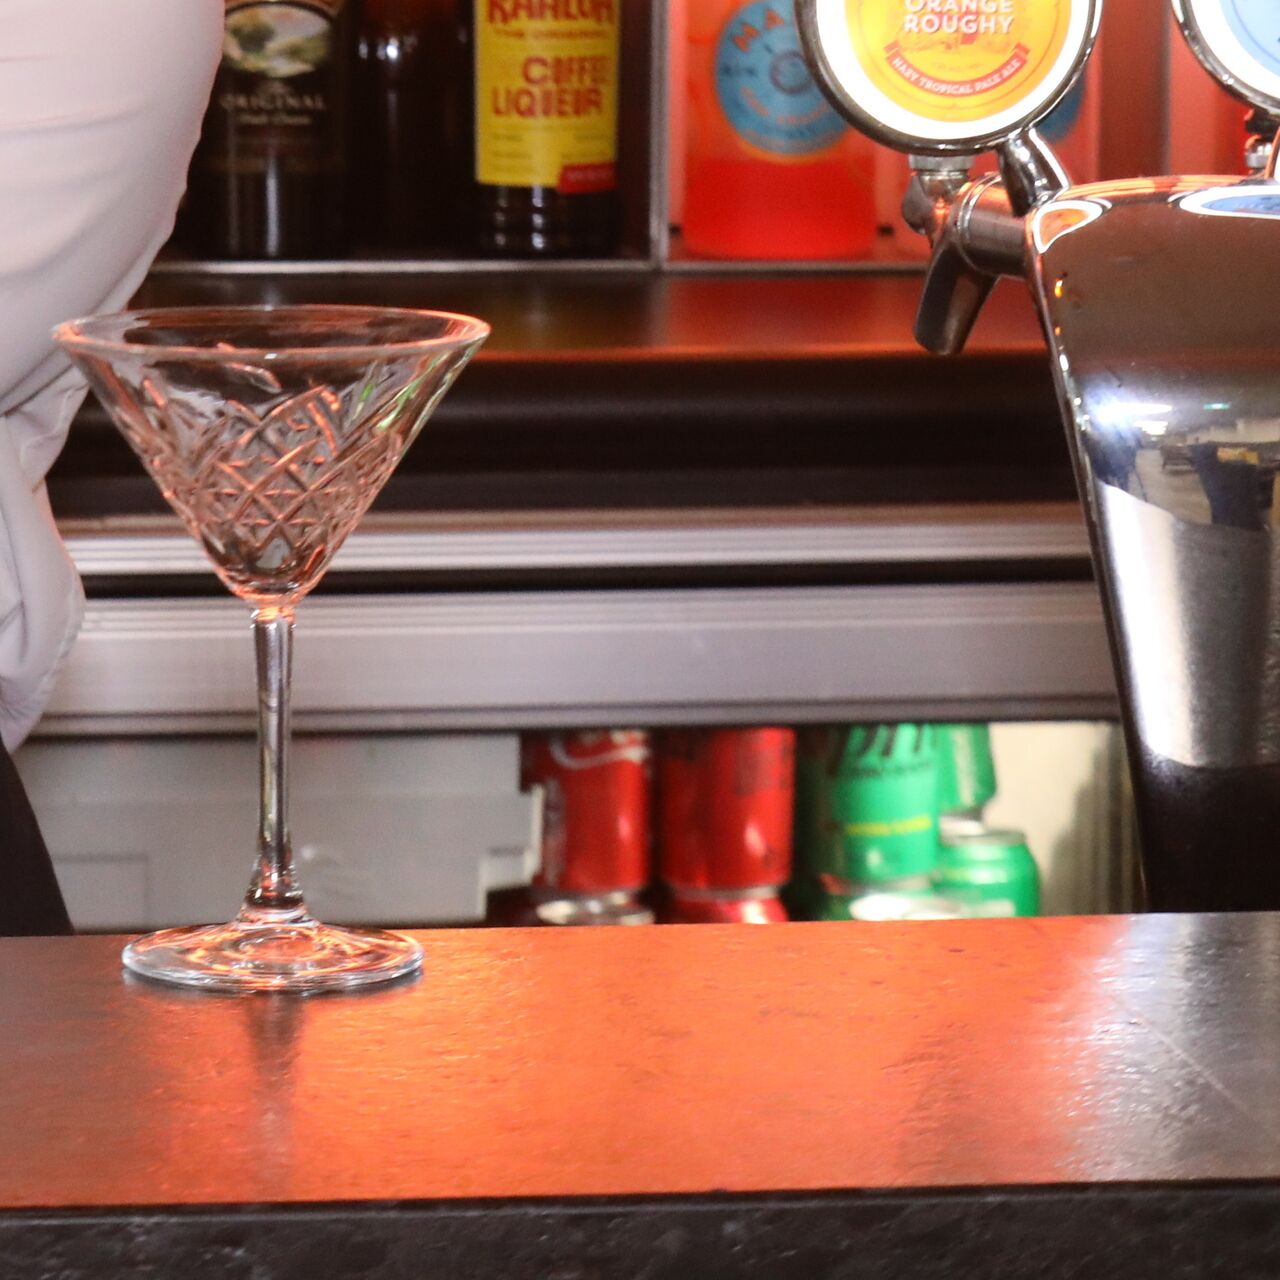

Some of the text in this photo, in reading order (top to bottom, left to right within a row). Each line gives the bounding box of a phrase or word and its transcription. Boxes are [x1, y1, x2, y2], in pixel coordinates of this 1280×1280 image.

[903, 14, 1015, 34] ROUGHY
[891, 56, 1022, 94] HAZY TROPICAL PALE ALE
